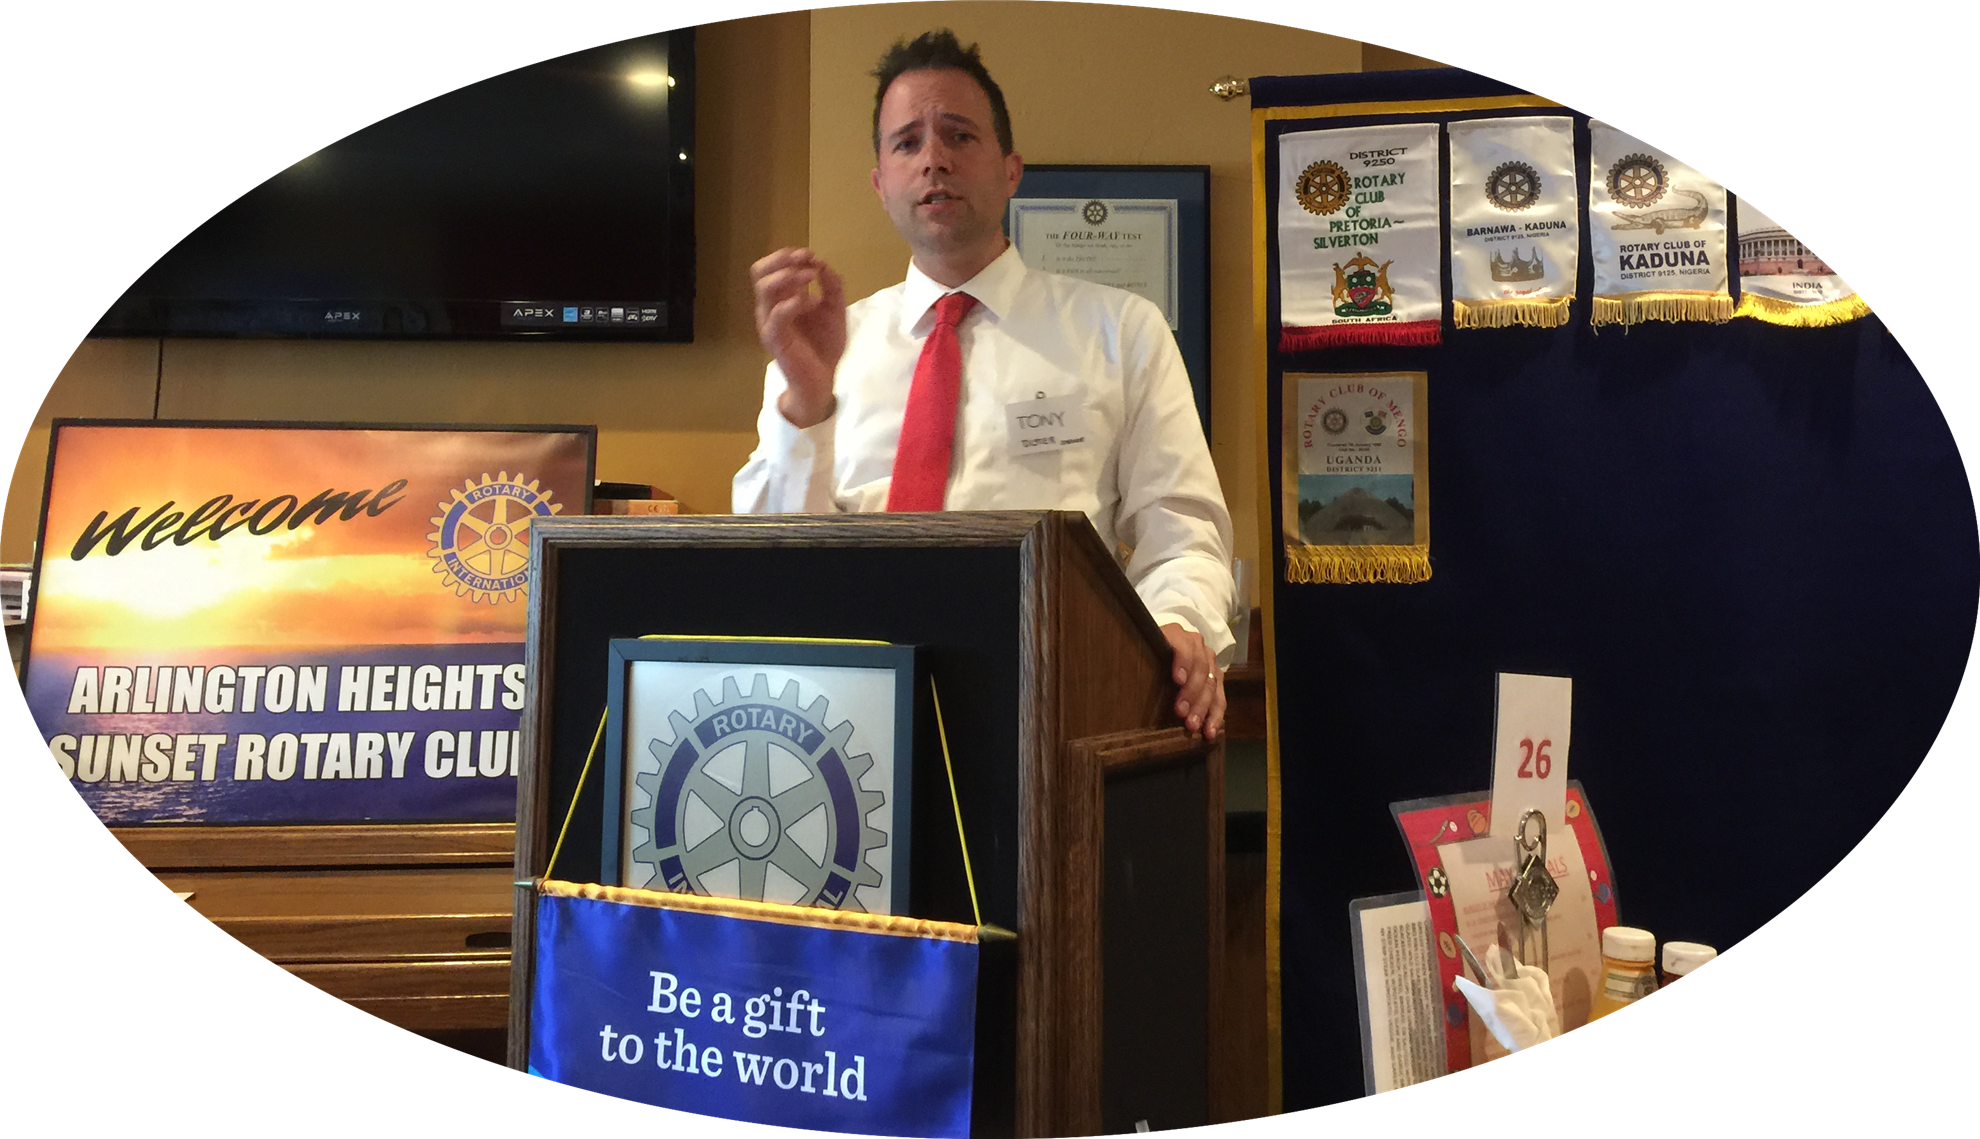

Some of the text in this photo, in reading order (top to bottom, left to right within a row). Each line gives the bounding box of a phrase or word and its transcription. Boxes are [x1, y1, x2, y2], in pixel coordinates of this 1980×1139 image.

[1349, 147, 1408, 160] DISTRICT
[1363, 158, 1396, 167] 9250
[1354, 173, 1406, 189] ROTARY
[1355, 192, 1385, 205] CLUB
[1345, 206, 1362, 218] OF
[1466, 225, 1516, 237] BARNAWA
[1525, 221, 1567, 232] KADUNA
[1314, 232, 1379, 250] SILVERTON
[1620, 240, 1706, 253] ROTARY CLUB OF
[1619, 250, 1711, 271] KADUNA
[1620, 270, 1656, 280] DISTRICT
[324, 312, 360, 320] APEX
[513, 308, 554, 318] APEX
[1015, 411, 1066, 430] TONY
[1303, 383, 1408, 449] ROTARY CLUB OF MENGO
[1326, 455, 1382, 465] UGANDA
[472, 485, 531, 500] ROTARY
[70, 478, 409, 562] Welcome
[448, 557, 529, 590] INTERNATIO
[67, 664, 525, 715] ARLINGTON HEIGHTS
[712, 708, 817, 745] ROTARY
[48, 732, 228, 783] SUNSET
[233, 731, 416, 781] ROTARY
[1517, 738, 1552, 780] 26
[647, 970, 826, 1039] Be a gift
[600, 1025, 868, 1103] to the world
